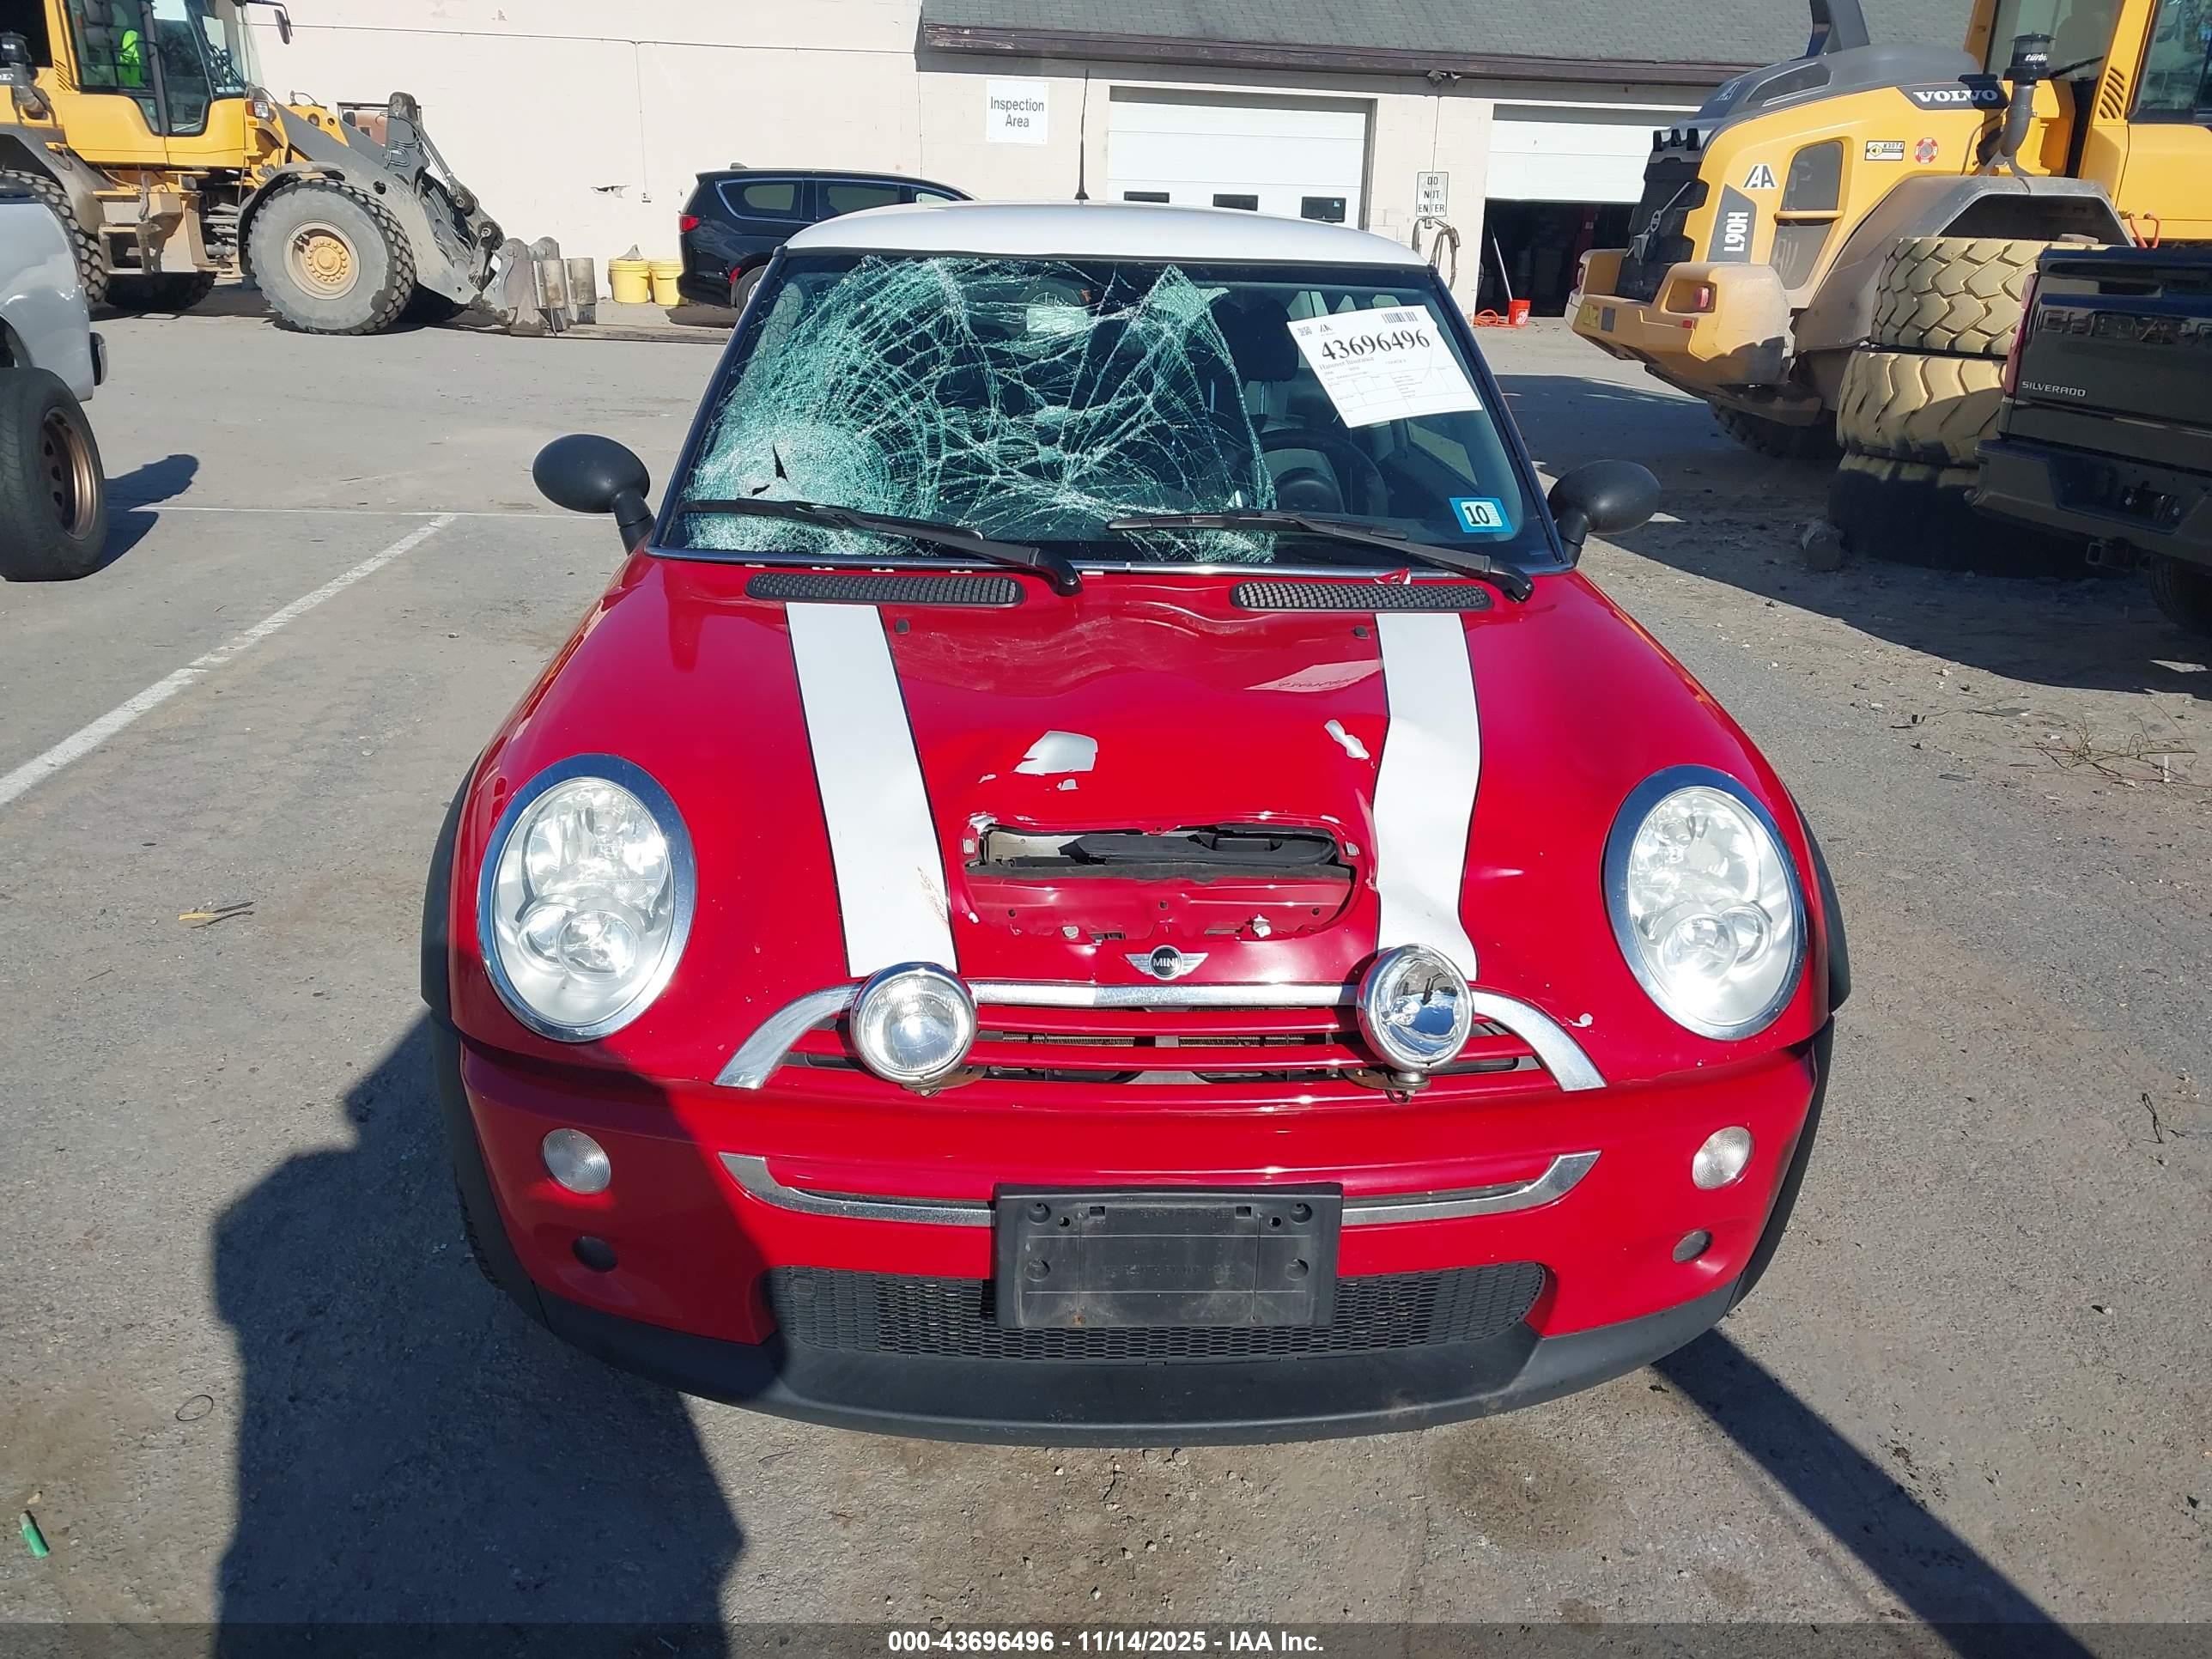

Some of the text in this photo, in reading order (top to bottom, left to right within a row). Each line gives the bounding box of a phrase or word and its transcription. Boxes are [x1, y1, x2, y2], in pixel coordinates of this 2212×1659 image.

[990, 96, 1044, 112] Inspection
[1913, 89, 1998, 103] VOLVO
[1006, 113, 1030, 128] Area
[1724, 211, 1749, 252] L90H
[1322, 329, 1431, 361] 43696496
[2021, 380, 2087, 397] SILVERADO
[1465, 505, 1490, 525] 10
[1152, 957, 1179, 968] MINI
